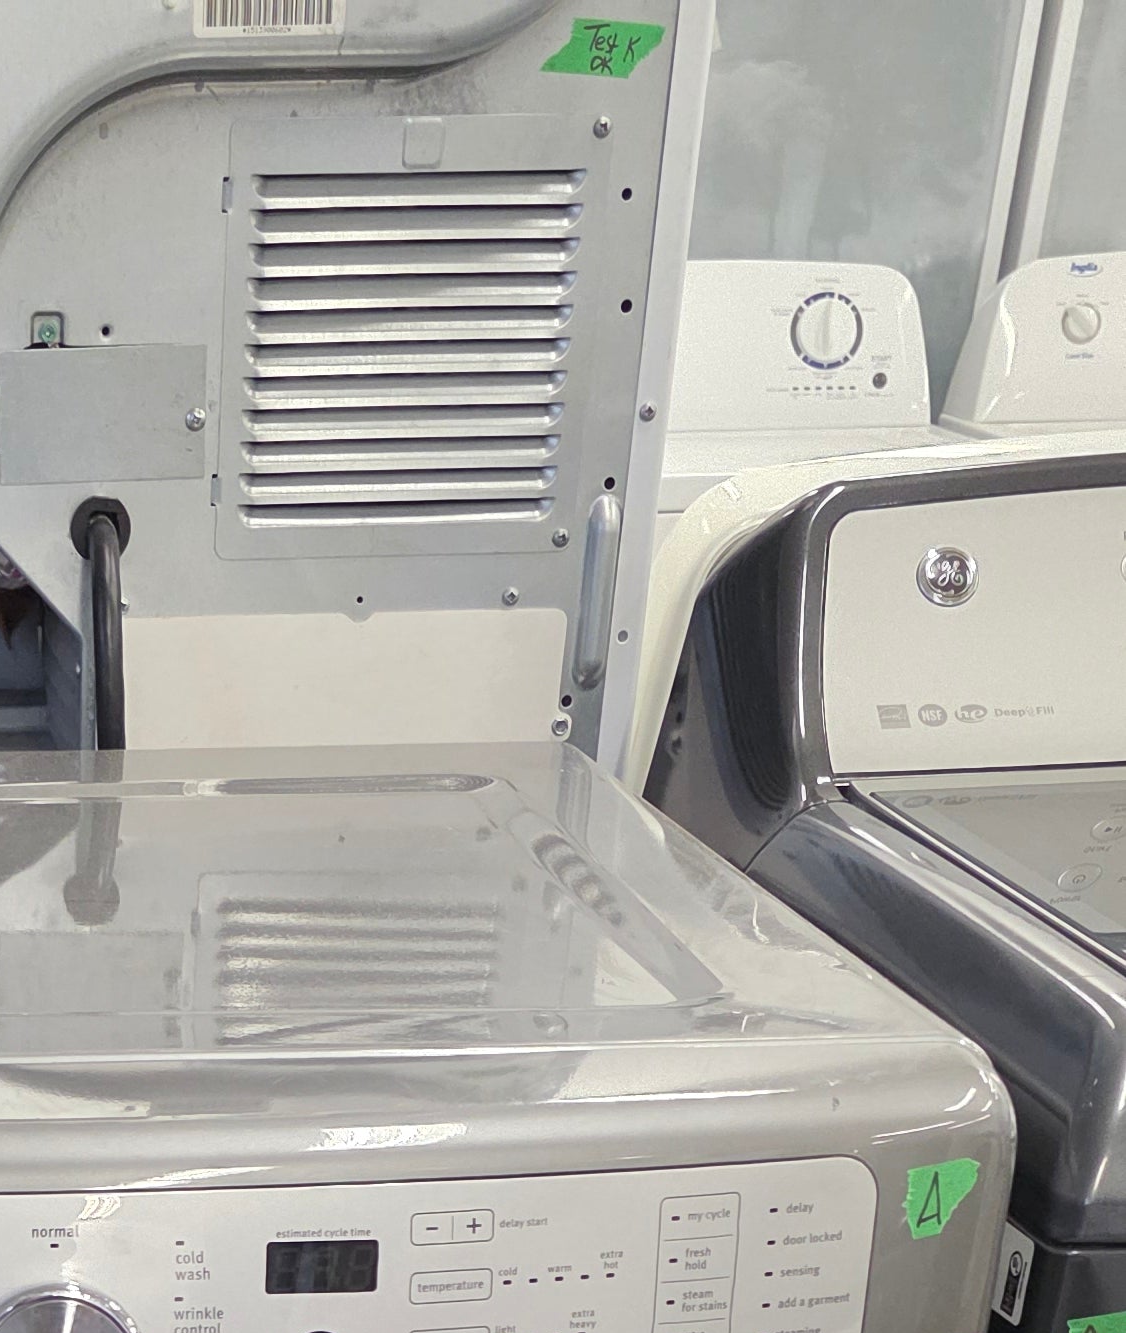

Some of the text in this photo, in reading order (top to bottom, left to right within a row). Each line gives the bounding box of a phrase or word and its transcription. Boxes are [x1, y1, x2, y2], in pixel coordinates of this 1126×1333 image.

[583, 23, 619, 54] Test
[590, 55, 613, 75] OK
[921, 709, 943, 721] NSF
[916, 1170, 942, 1229] A
[786, 1203, 814, 1214] delay
[687, 1208, 731, 1223] my cycle
[499, 1217, 549, 1229] delay start
[31, 1224, 80, 1239] normal
[276, 1228, 372, 1239] estimated cycle time
[783, 1230, 843, 1246] door locked
[175, 1251, 204, 1264] cold
[600, 1250, 624, 1259] extra
[685, 1247, 711, 1258] fresh
[547, 1264, 572, 1273] warm
[604, 1261, 619, 1270] hot
[684, 1259, 707, 1270] hold
[780, 1264, 821, 1277] sensing
[174, 1267, 211, 1281] wash
[498, 1267, 518, 1277] cold
[417, 1280, 484, 1293] temperature
[682, 1290, 714, 1300] steam
[778, 1292, 850, 1309] add a garment
[681, 1300, 728, 1312] for stains
[173, 1306, 224, 1320] wrinkle
[571, 1309, 595, 1318] extra
[569, 1320, 597, 1330] heavy
